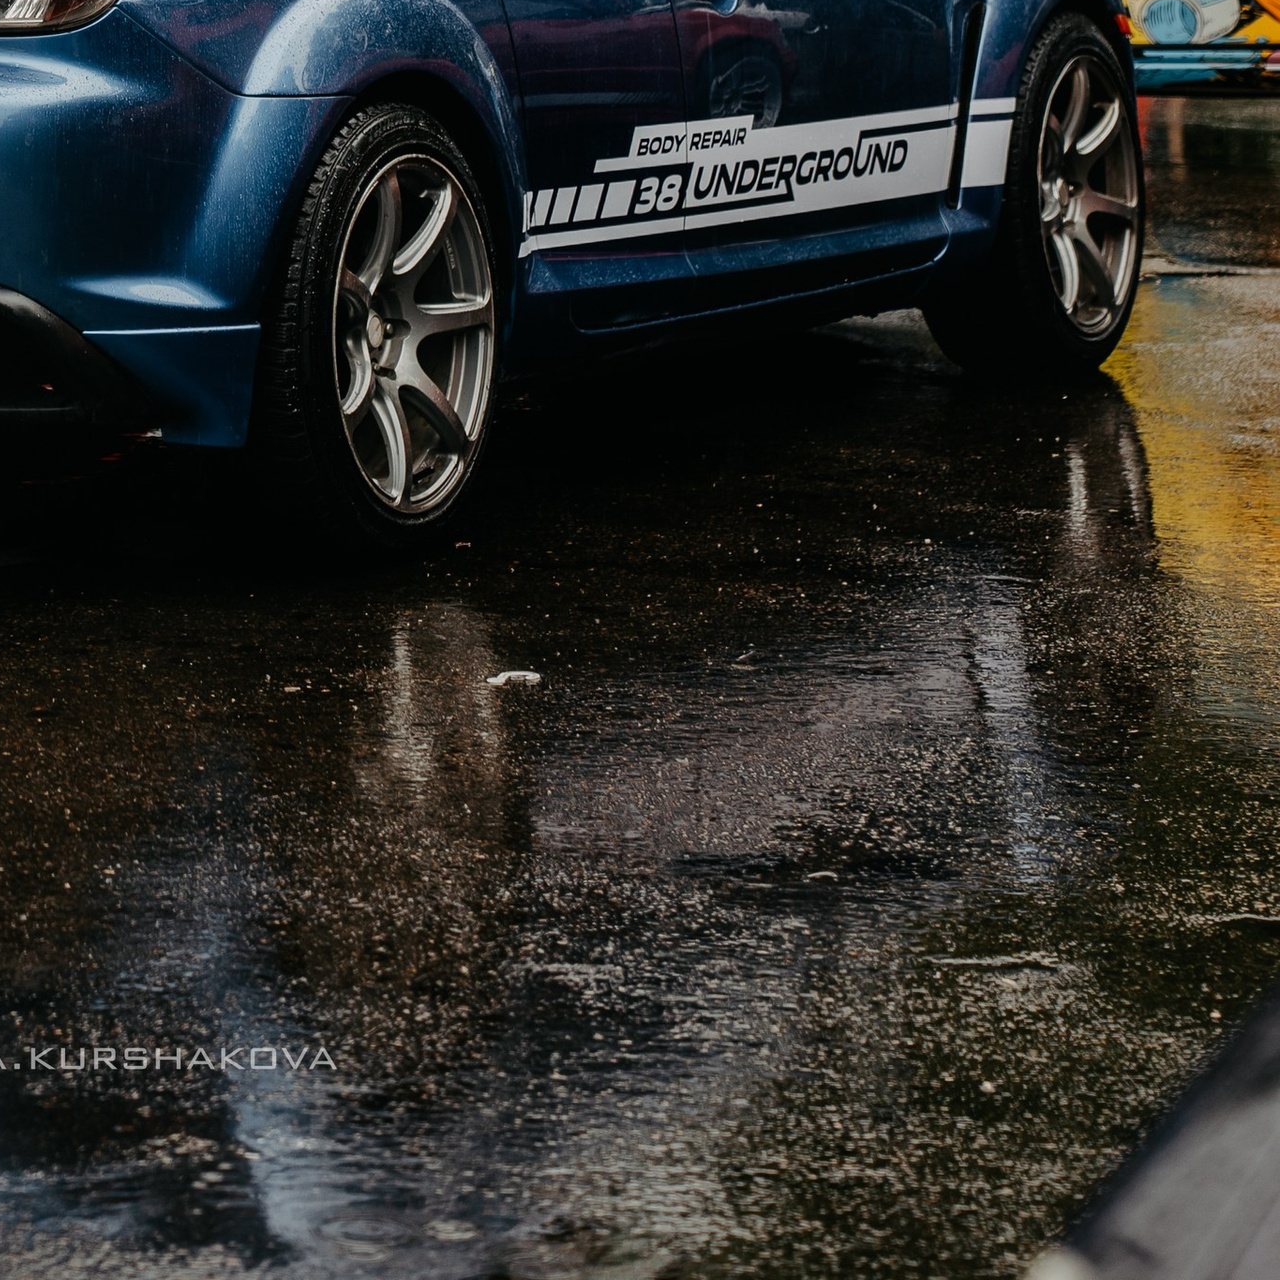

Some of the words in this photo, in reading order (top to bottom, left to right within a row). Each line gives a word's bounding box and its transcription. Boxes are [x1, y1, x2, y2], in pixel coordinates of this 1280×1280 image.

[637, 134, 687, 157] BODY
[689, 127, 747, 151] REPAIR
[633, 173, 684, 215] 38
[691, 139, 909, 201] UNDERGROUND
